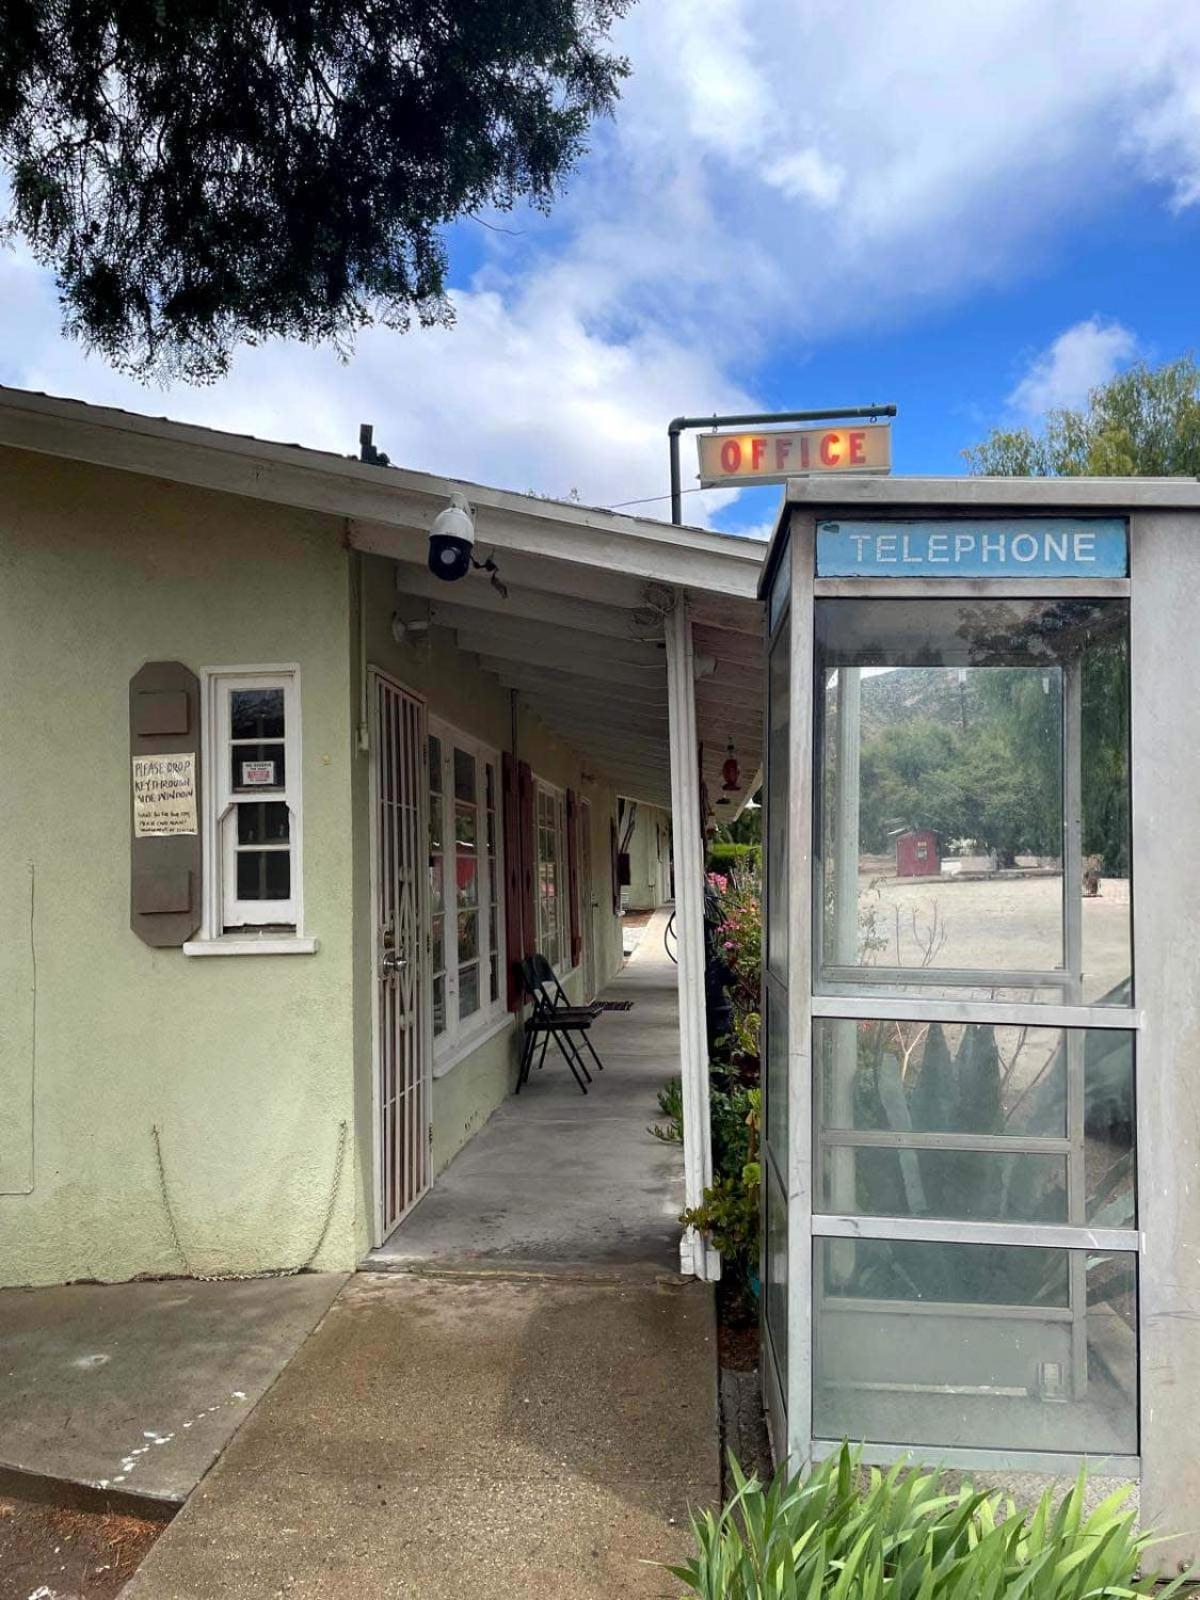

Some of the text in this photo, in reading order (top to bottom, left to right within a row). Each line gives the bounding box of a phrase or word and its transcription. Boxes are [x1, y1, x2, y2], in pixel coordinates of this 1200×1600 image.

[720, 432, 866, 474] OFFICE
[850, 533, 1096, 562] TELEPHONE
[135, 760, 191, 777] PLEASE DROP
